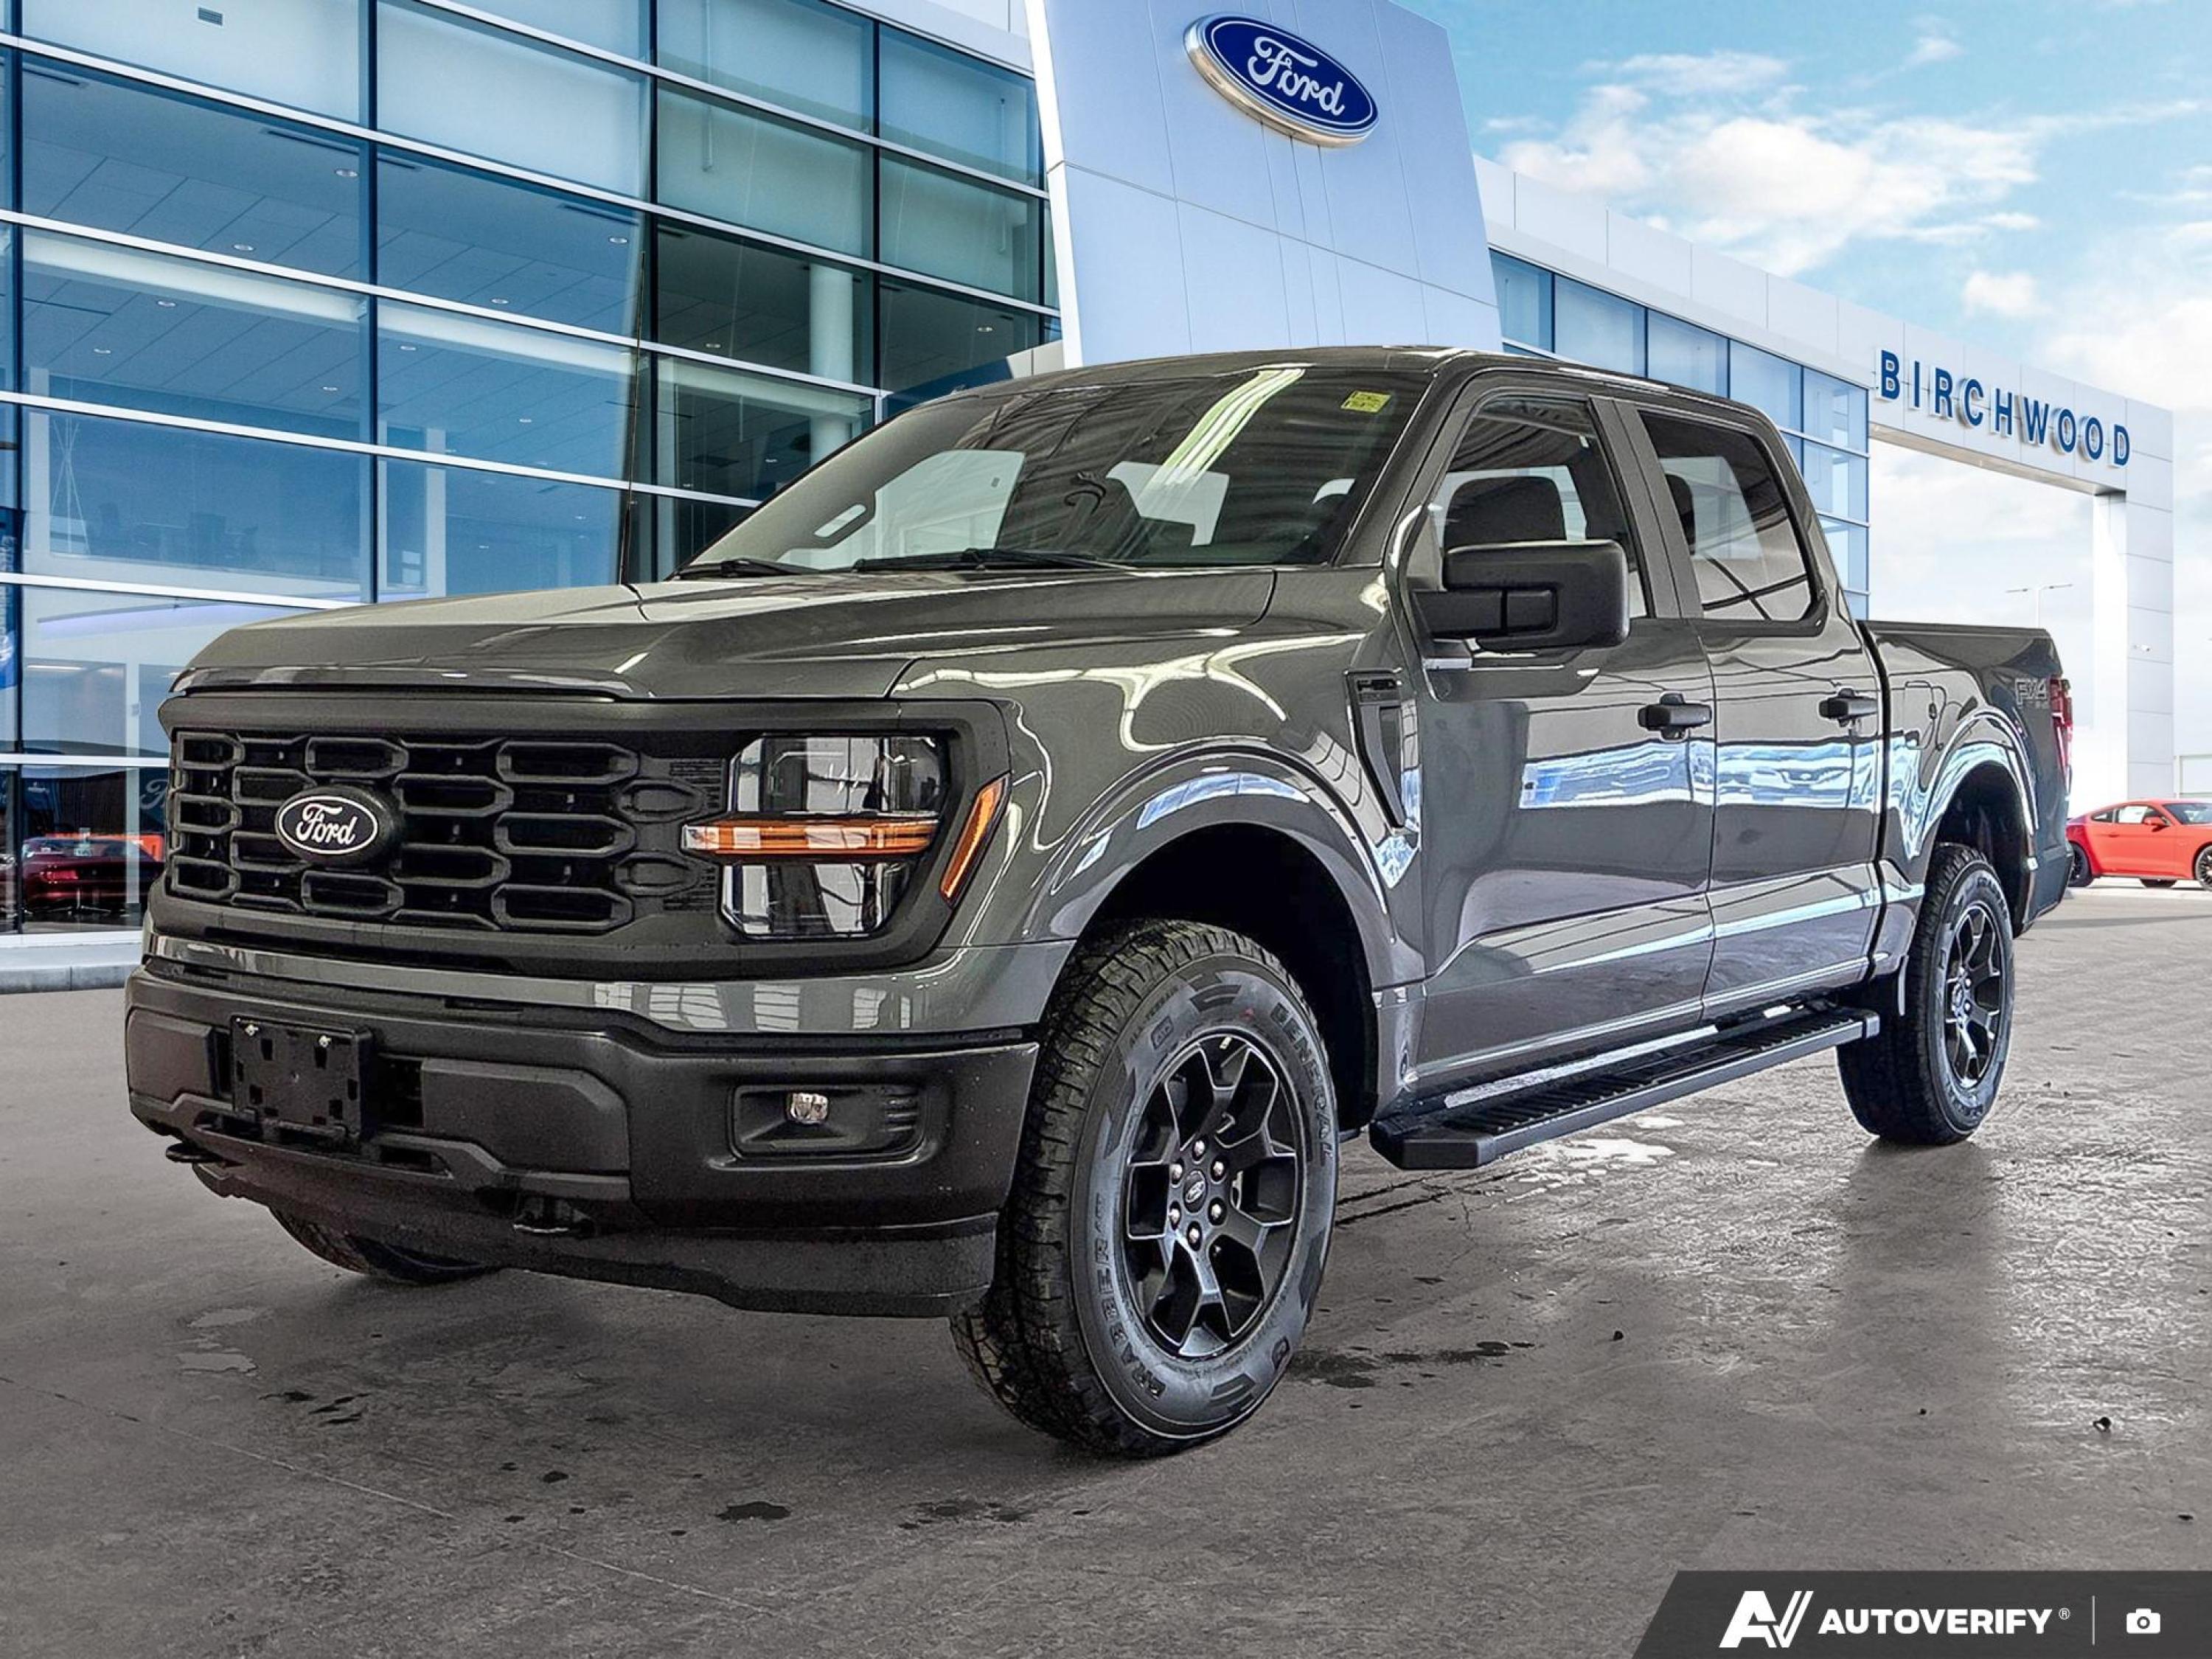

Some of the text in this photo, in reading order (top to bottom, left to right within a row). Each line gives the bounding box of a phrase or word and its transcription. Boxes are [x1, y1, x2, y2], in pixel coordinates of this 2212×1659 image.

[1248, 36, 1345, 116] Ford
[1880, 349, 2131, 467] BIRCHWOOD
[296, 803, 358, 845] Ford
[1270, 1001, 1333, 1166] GENERAL
[1096, 1237, 1166, 1399] GRABBER
